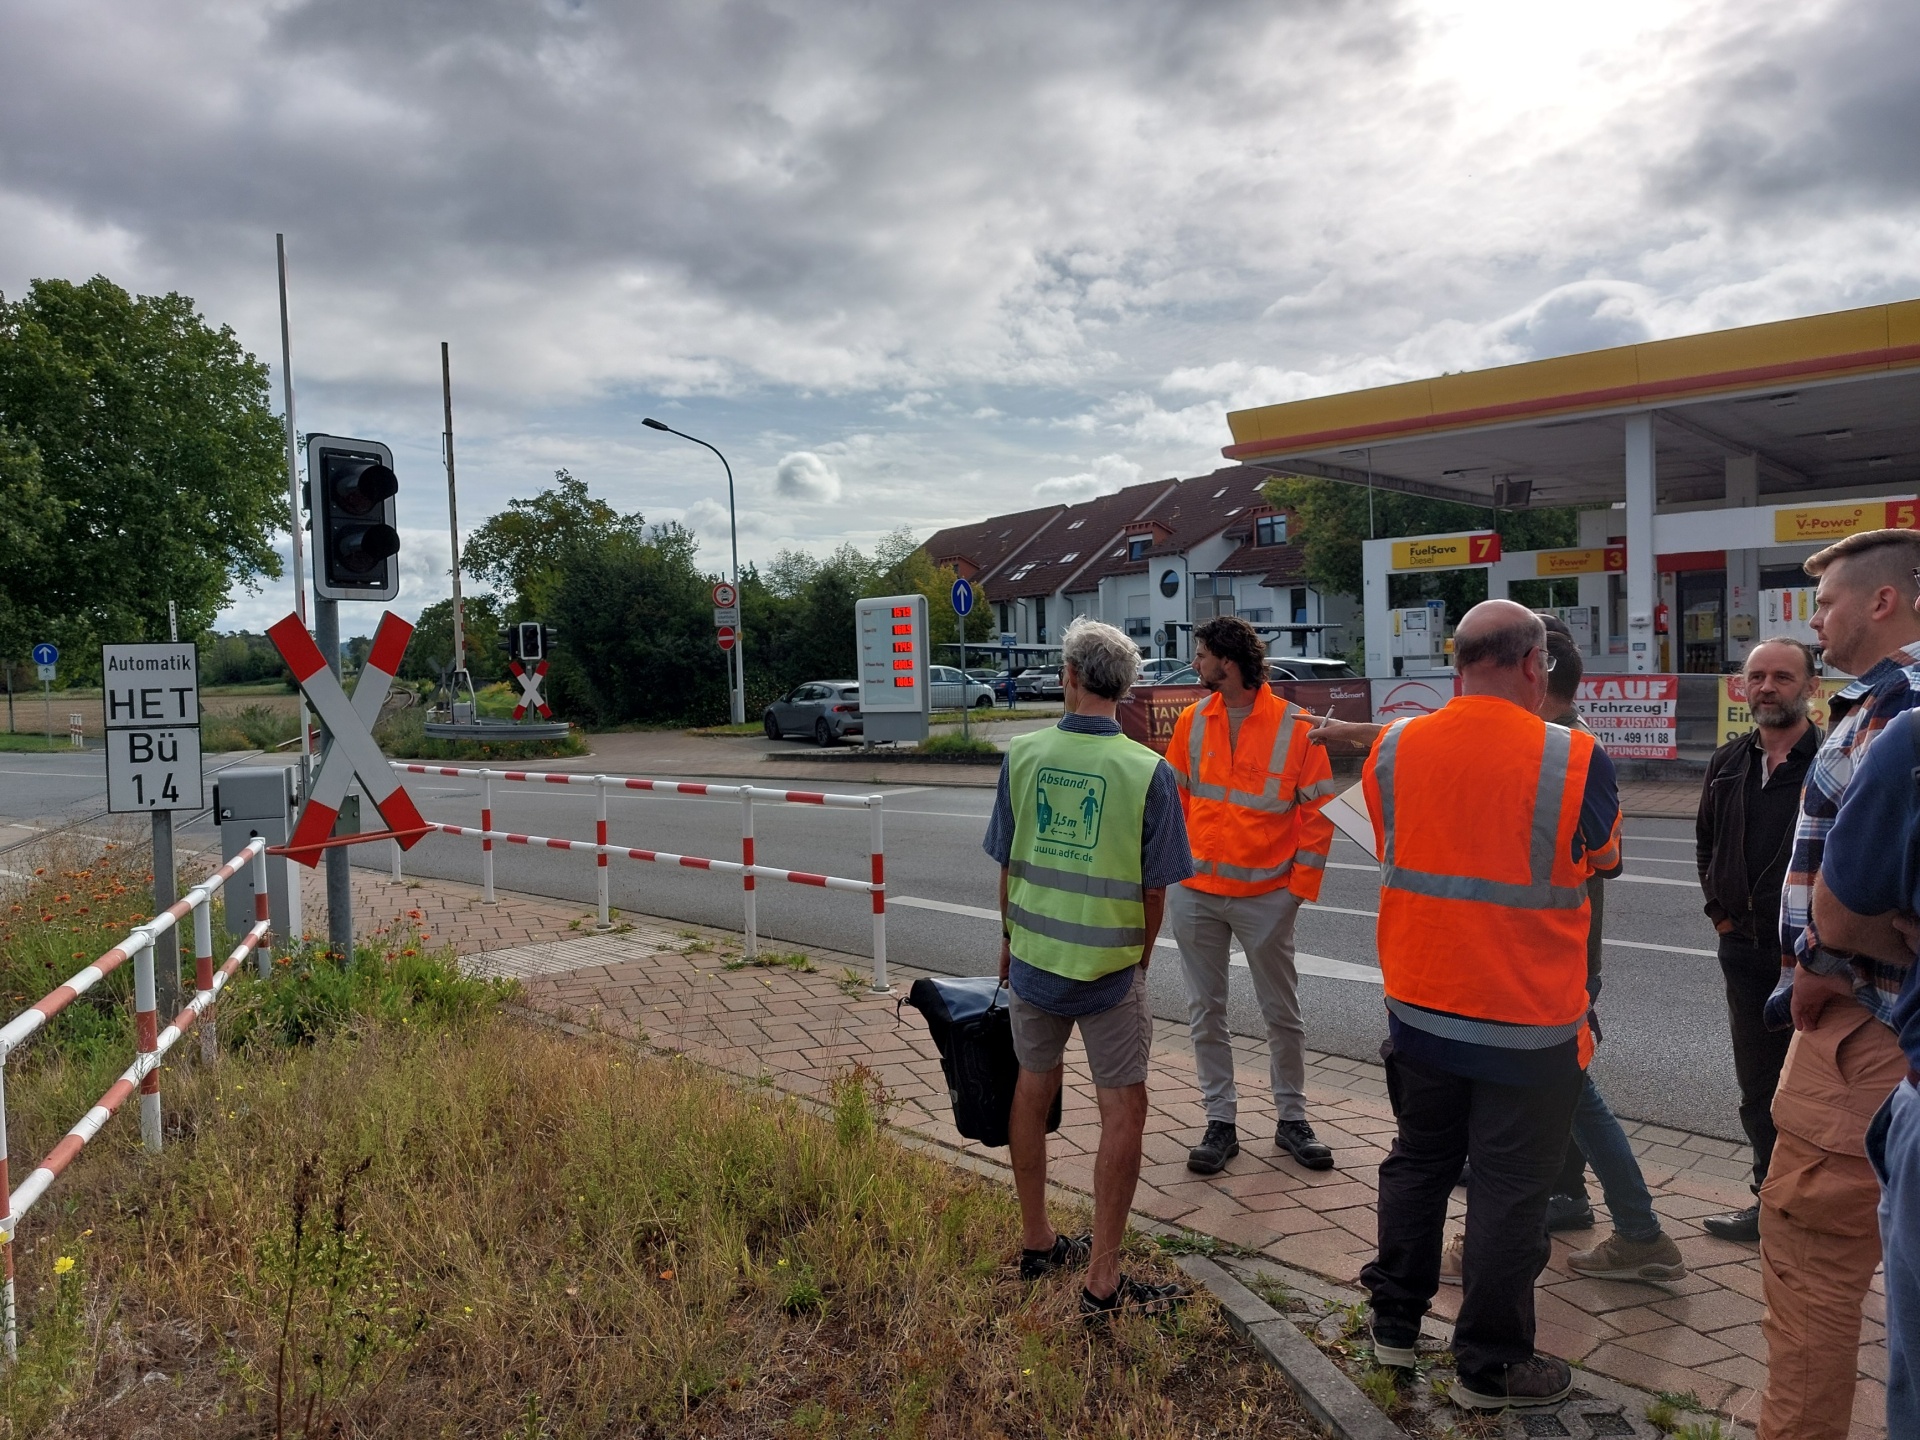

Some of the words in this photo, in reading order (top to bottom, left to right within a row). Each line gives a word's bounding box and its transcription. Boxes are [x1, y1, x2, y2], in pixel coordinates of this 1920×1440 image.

[1896, 505, 1916, 528] 5
[1796, 518, 1860, 530] V-Power
[1410, 545, 1457, 556] FuelSave
[1476, 539, 1492, 558] 7
[1410, 555, 1434, 565] Diesel
[1550, 559, 1588, 567] V-Power
[1609, 551, 1622, 567] 3
[108, 655, 192, 671] Automatik
[1330, 691, 1365, 699] ClubSmart
[1576, 681, 1668, 699] KAUF
[109, 687, 194, 720] HET
[1591, 702, 1668, 715] Fahrzeug!
[1152, 706, 1186, 719] TAN
[1154, 722, 1173, 735] JA
[1588, 718, 1618, 728] JEDER
[1620, 718, 1669, 728] ZUSTAND
[1624, 732, 1642, 743] 499
[1645, 732, 1654, 743] 11
[1658, 733, 1669, 744] 88
[129, 733, 178, 764] Bü
[1607, 747, 1669, 756] PFUNGSTADT
[1039, 773, 1089, 790] Abstand!
[131, 773, 180, 807] 1,4
